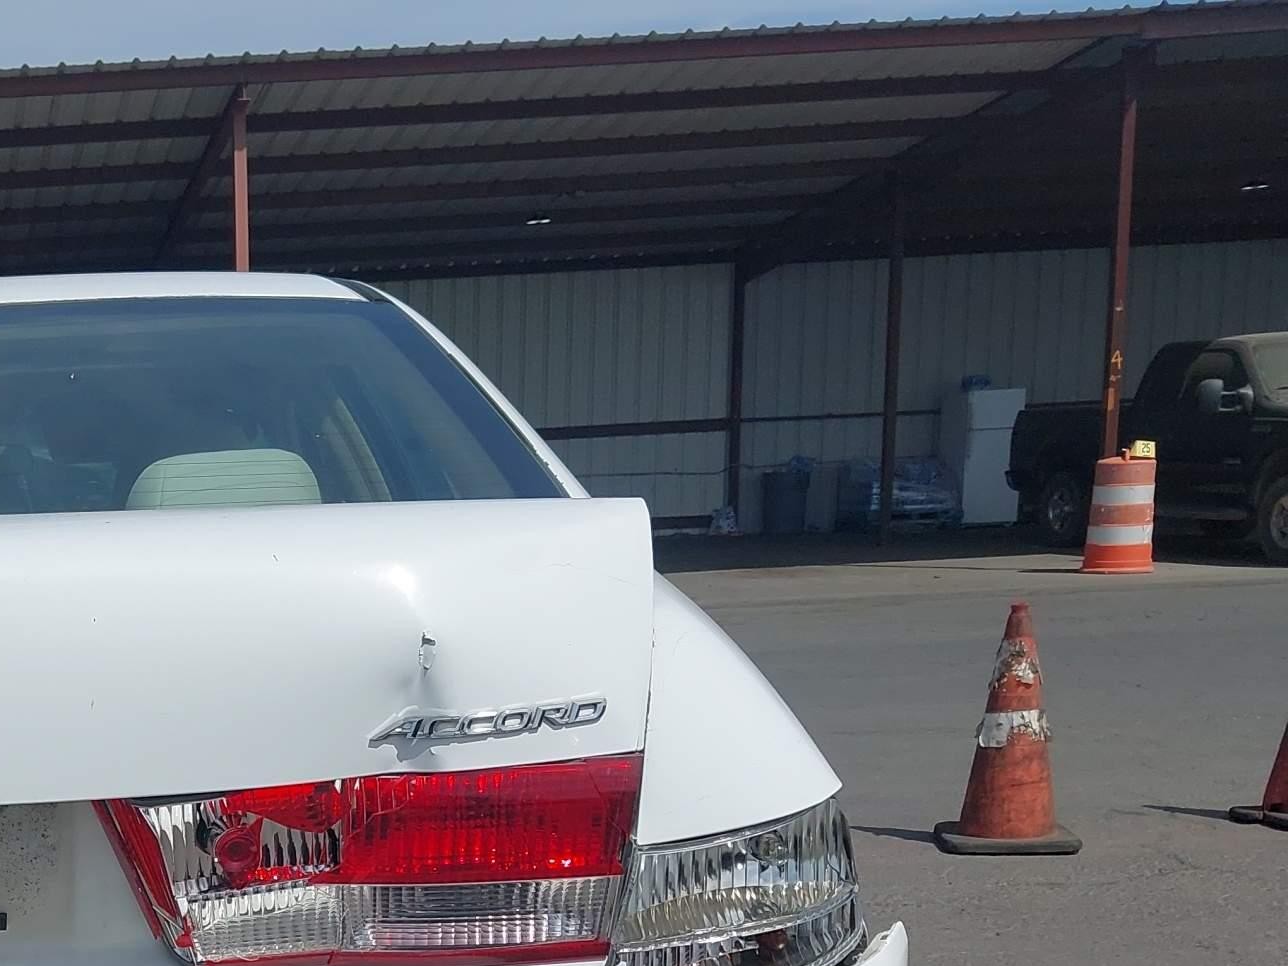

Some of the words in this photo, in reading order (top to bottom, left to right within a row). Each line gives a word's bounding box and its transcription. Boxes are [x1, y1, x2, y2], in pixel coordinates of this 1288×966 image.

[1111, 349, 1123, 370] 4
[1142, 443, 1151, 454] 25
[368, 696, 607, 746] ACCORD
